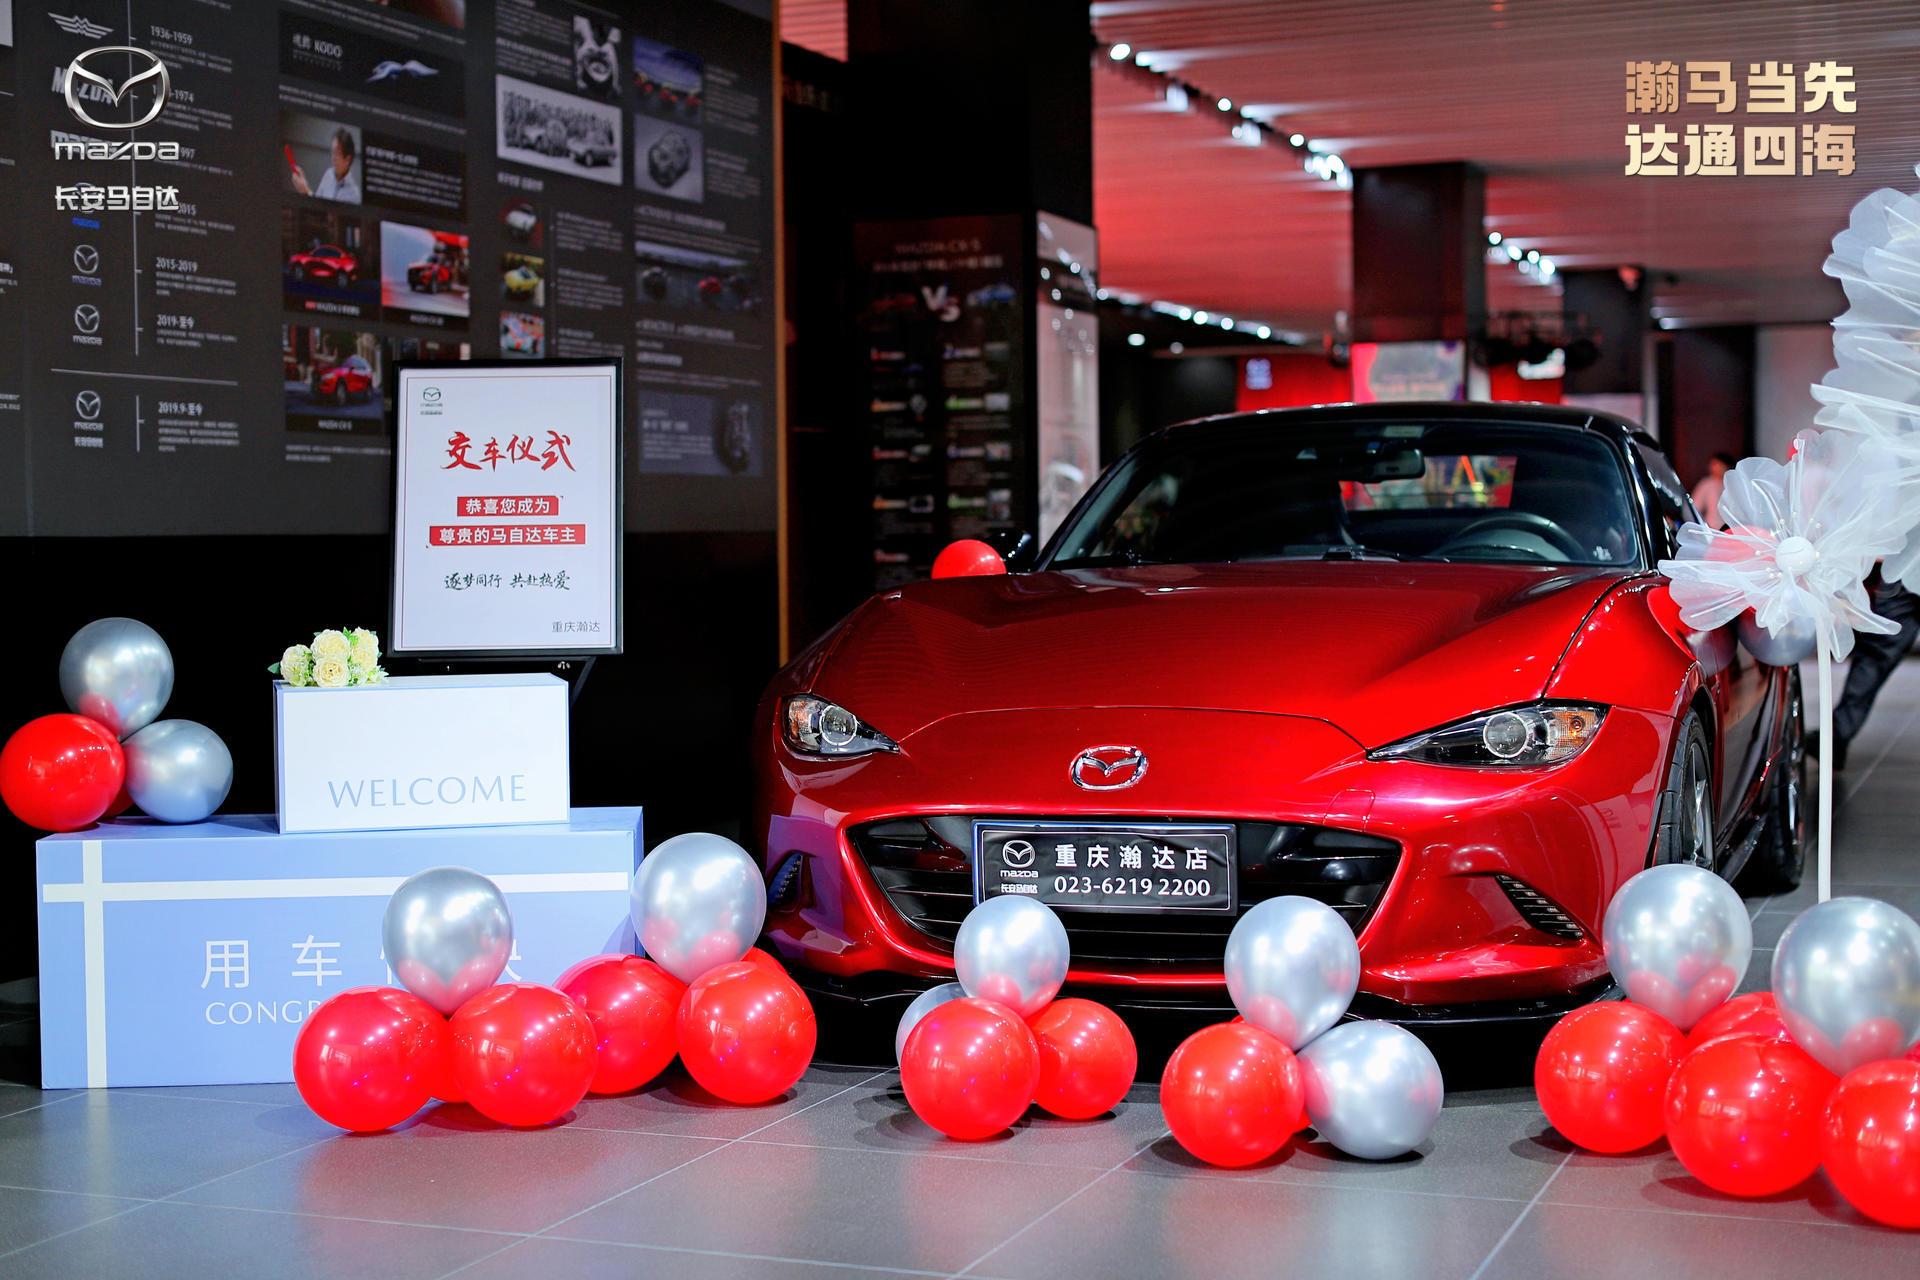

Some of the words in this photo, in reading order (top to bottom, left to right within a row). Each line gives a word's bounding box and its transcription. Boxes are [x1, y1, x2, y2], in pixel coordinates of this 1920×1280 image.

[440, 430, 577, 473] 交车仪式
[465, 497, 551, 515] 恭喜您成为
[438, 526, 577, 544] 尊贵的马自达车主
[444, 571, 502, 591] 逐梦同行
[509, 569, 571, 591] 共赴热爱
[551, 620, 600, 633] 重庆瀚达
[327, 773, 527, 809] WELCOME
[1054, 844, 1208, 871] 重庆瀚达店
[1054, 875, 1153, 896] 023-6219
[1157, 878, 1211, 897] 2200
